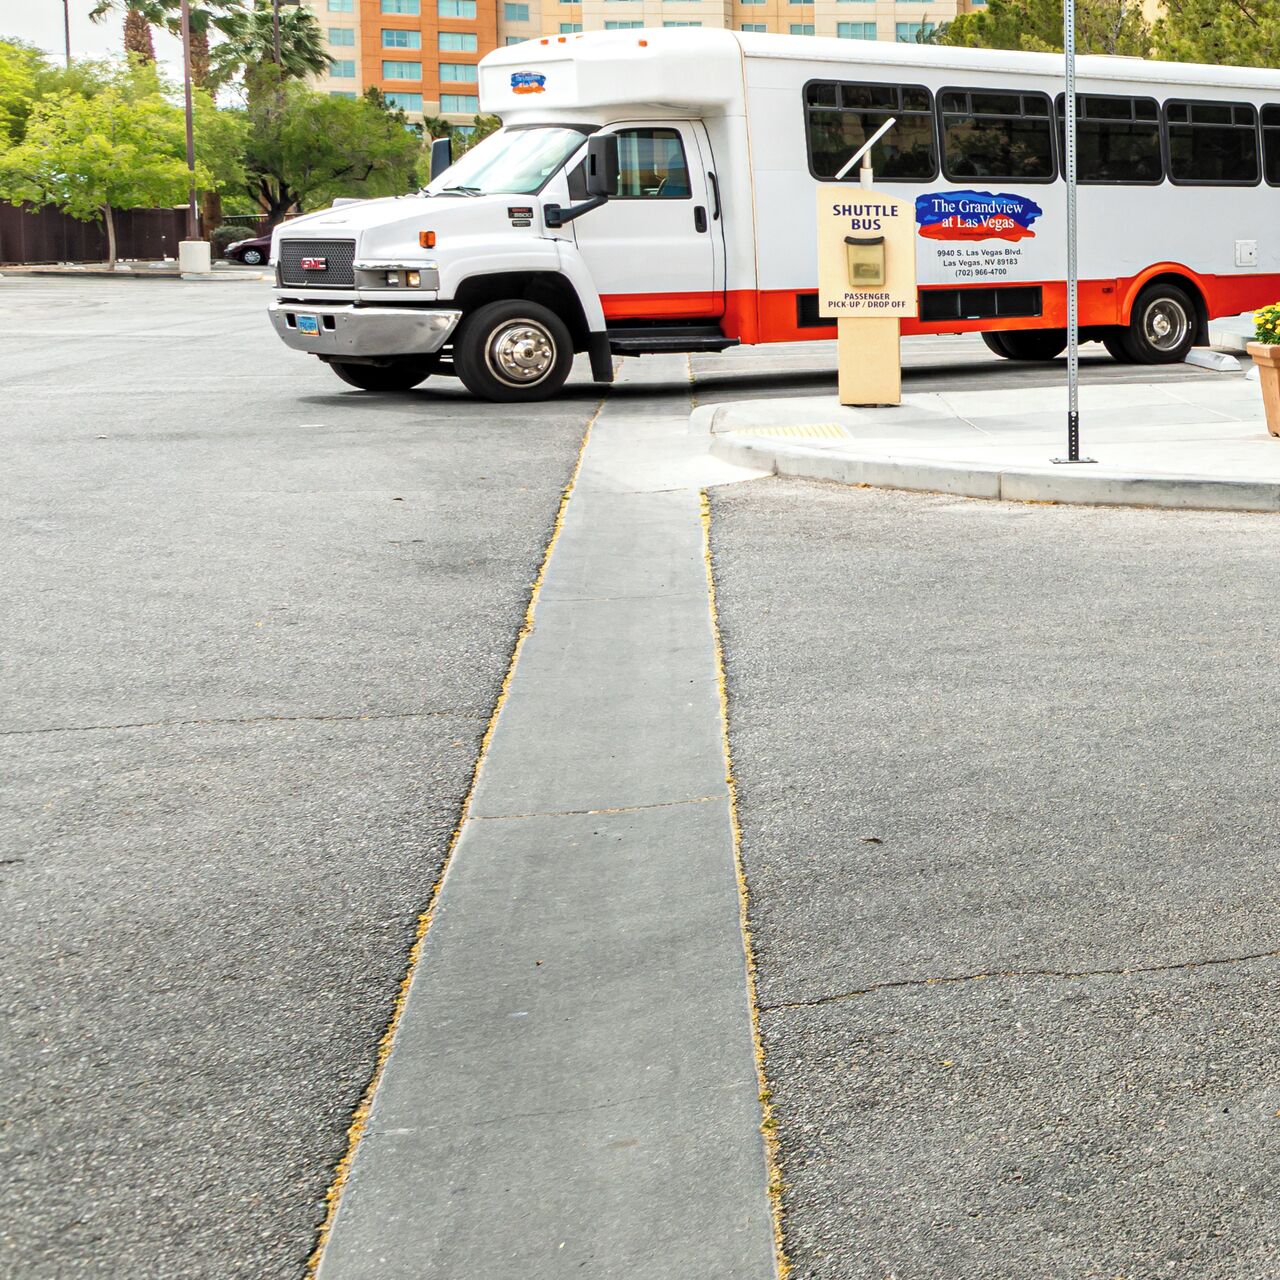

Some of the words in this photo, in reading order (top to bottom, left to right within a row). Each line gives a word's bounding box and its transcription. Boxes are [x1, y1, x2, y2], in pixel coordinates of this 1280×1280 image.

[833, 204, 898, 216] SHUTTLE
[931, 199, 955, 213] The
[958, 200, 1023, 213] Grandview
[851, 219, 881, 230] BUS
[942, 217, 953, 228] at
[956, 215, 978, 228] Las
[980, 215, 1014, 231] Vegas
[937, 249, 955, 257] 9940
[980, 249, 1003, 257] Vegas
[301, 257, 326, 269] GMC
[955, 269, 974, 277] (702)
[975, 268, 1007, 276] 966-4700
